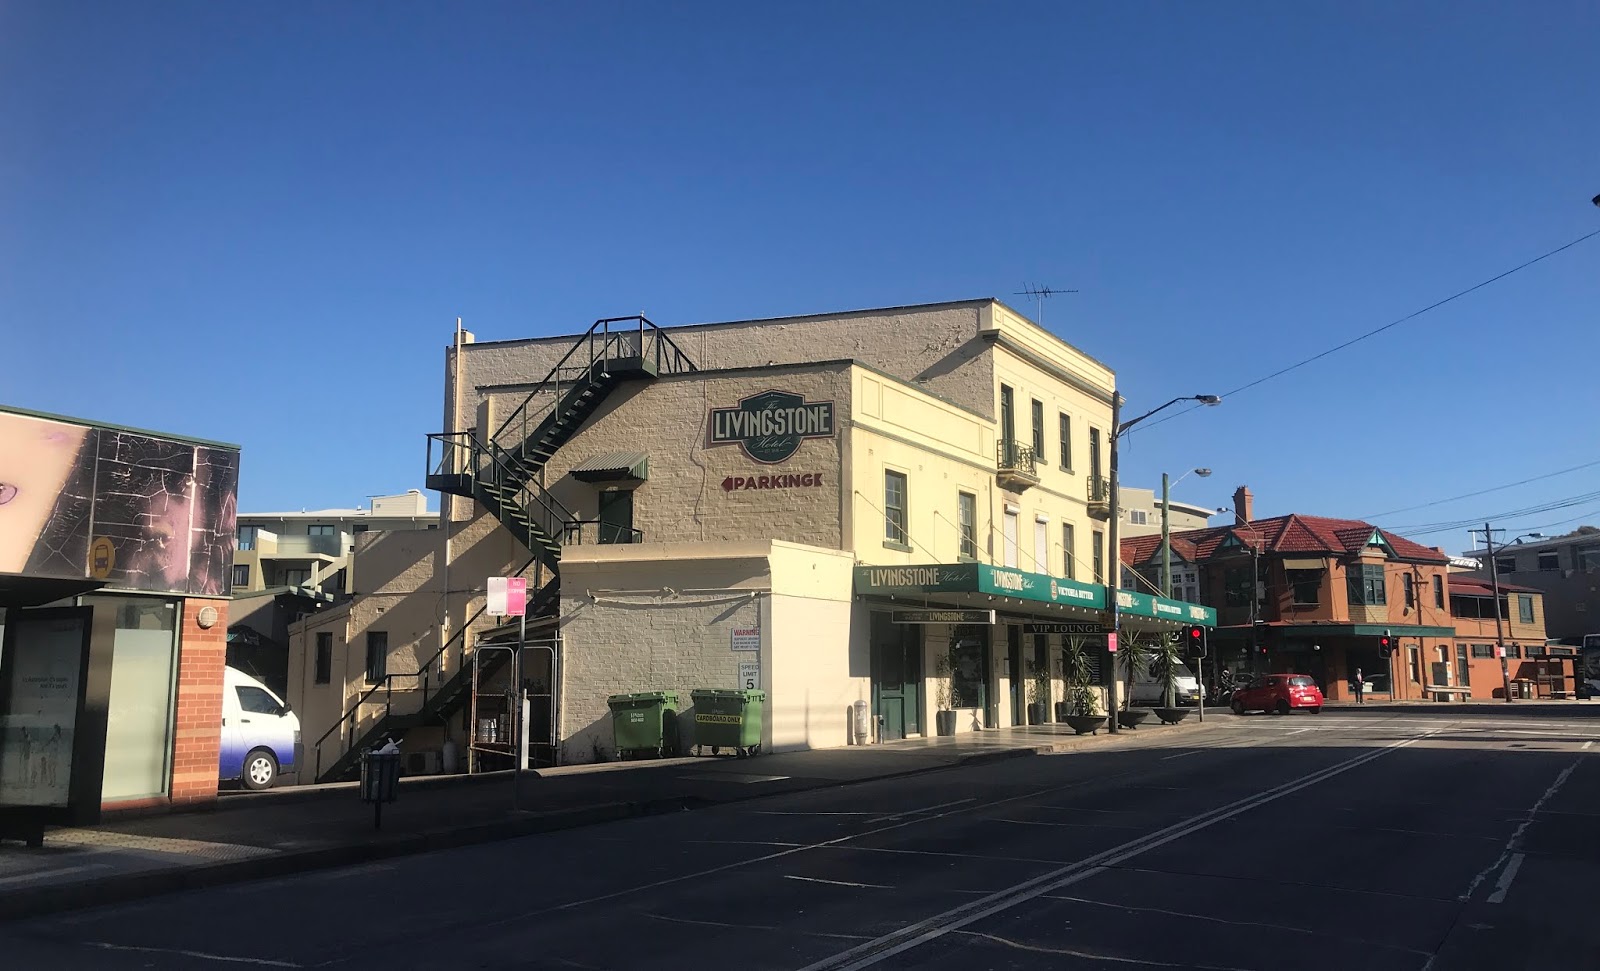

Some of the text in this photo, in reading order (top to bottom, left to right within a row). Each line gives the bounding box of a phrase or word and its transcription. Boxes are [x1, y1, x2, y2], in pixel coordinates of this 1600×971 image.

[762, 400, 779, 410] The
[715, 407, 829, 438] LIVINGSTONE
[751, 435, 793, 449] Hotel
[733, 474, 814, 490] PARKING
[870, 568, 940, 586] LIVINGSTONE
[939, 570, 972, 582] Hotel
[929, 612, 965, 621] LIVINGSTONE
[1032, 624, 1100, 633] VIP LOUNGE
[746, 679, 754, 690] 5
[696, 714, 741, 724] CARDBOARD ONLY
